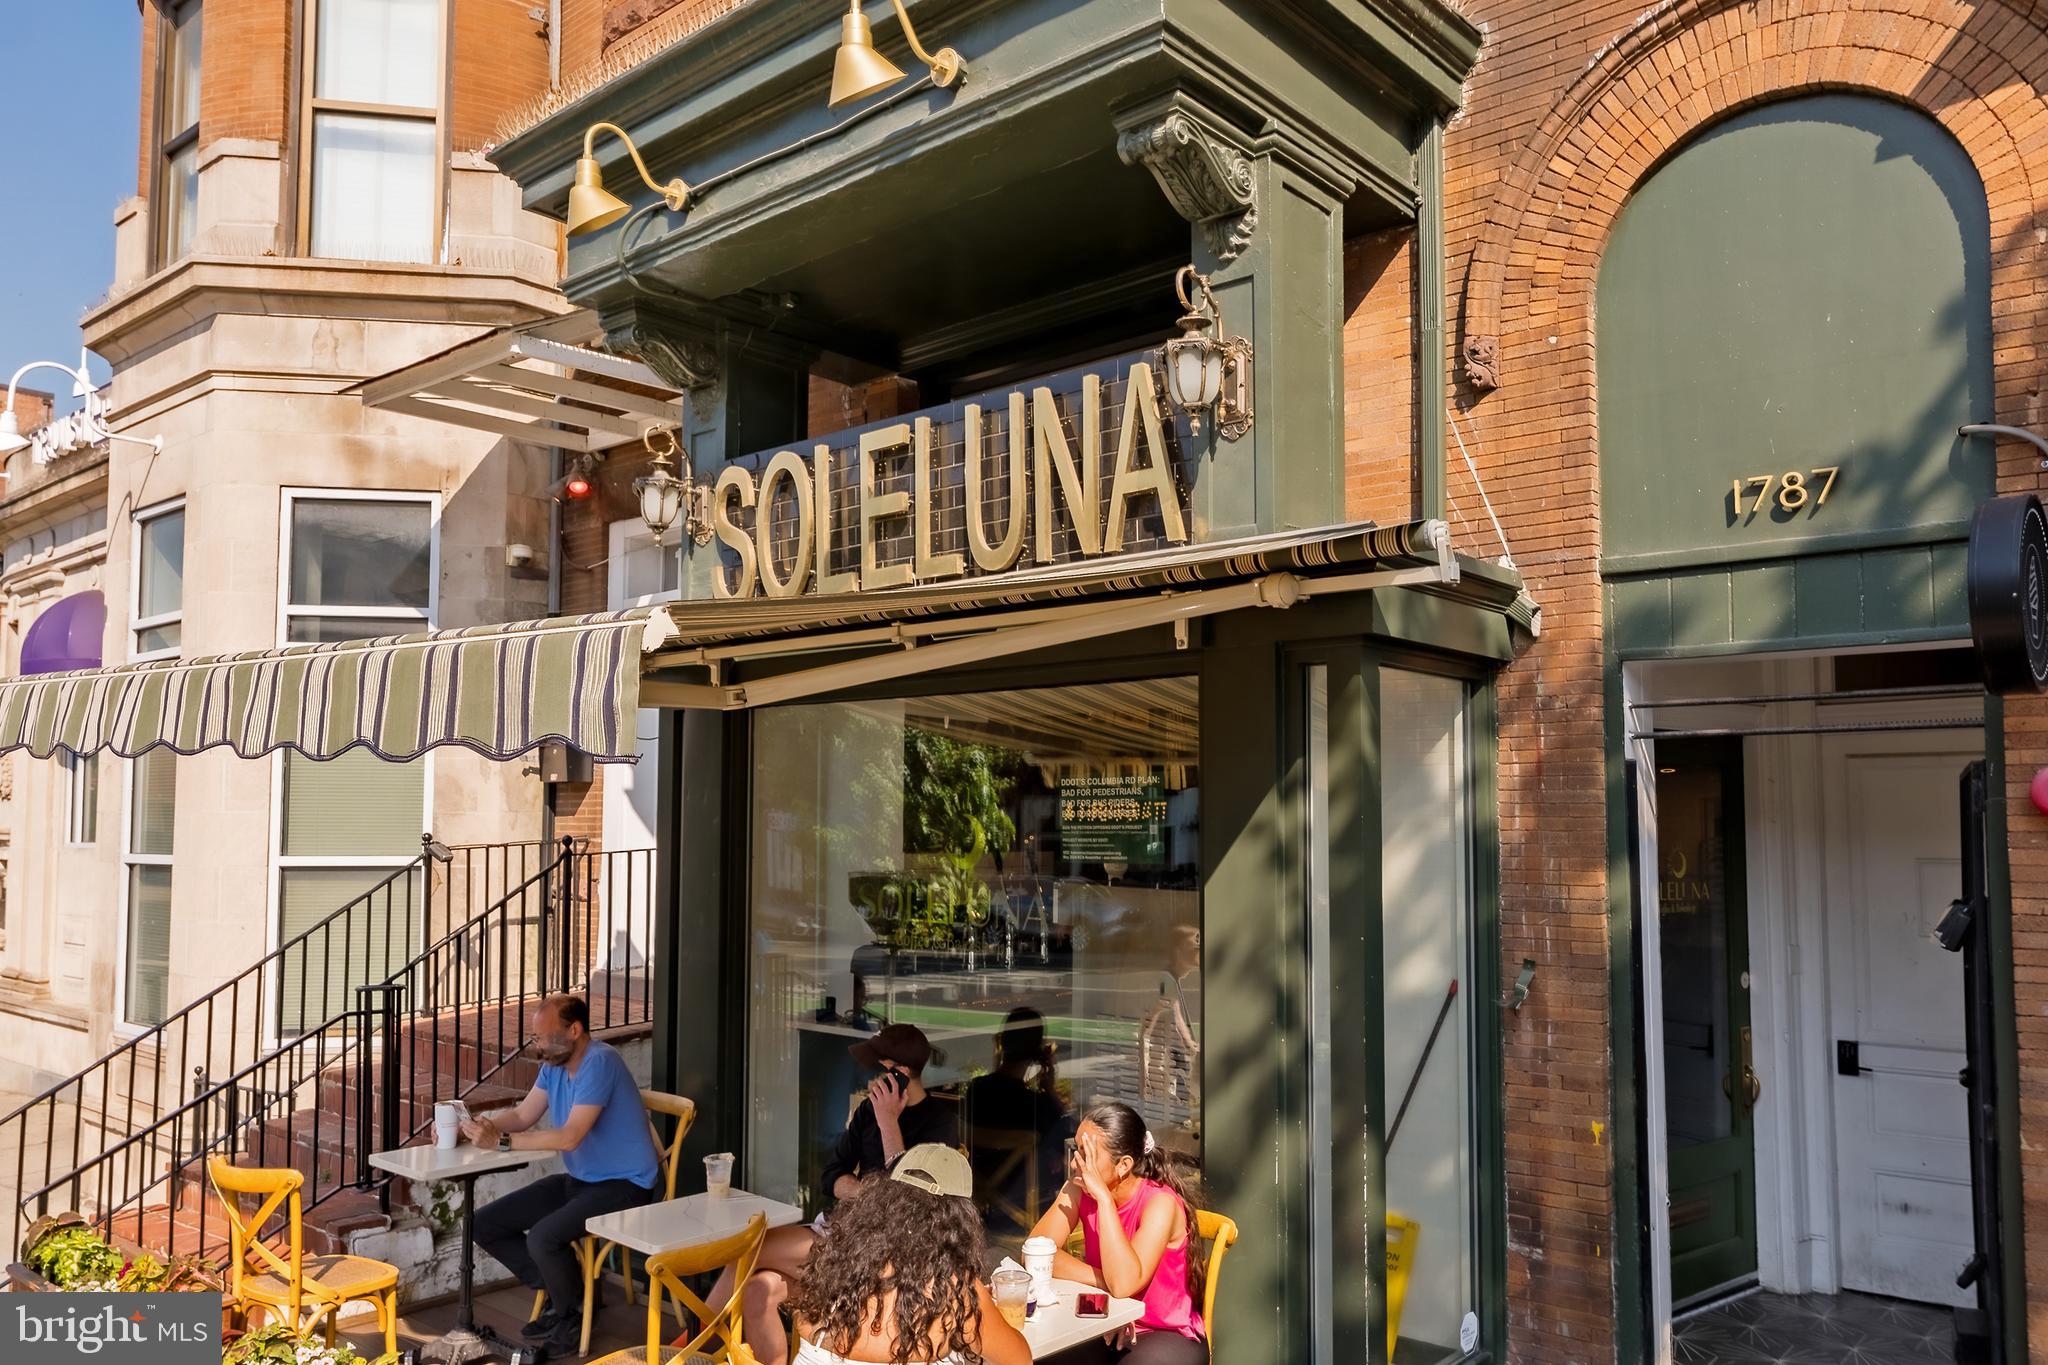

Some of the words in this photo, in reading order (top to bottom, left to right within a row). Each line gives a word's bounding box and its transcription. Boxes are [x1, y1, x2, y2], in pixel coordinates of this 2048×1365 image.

[712, 362, 1187, 599] SOLELUNA
[1733, 466, 1839, 515] 1787
[1061, 789, 1076, 797] BAD
[1076, 788, 1091, 797] FOR
[1087, 777, 1124, 786] COLUMBIA
[1125, 776, 1136, 785] RD
